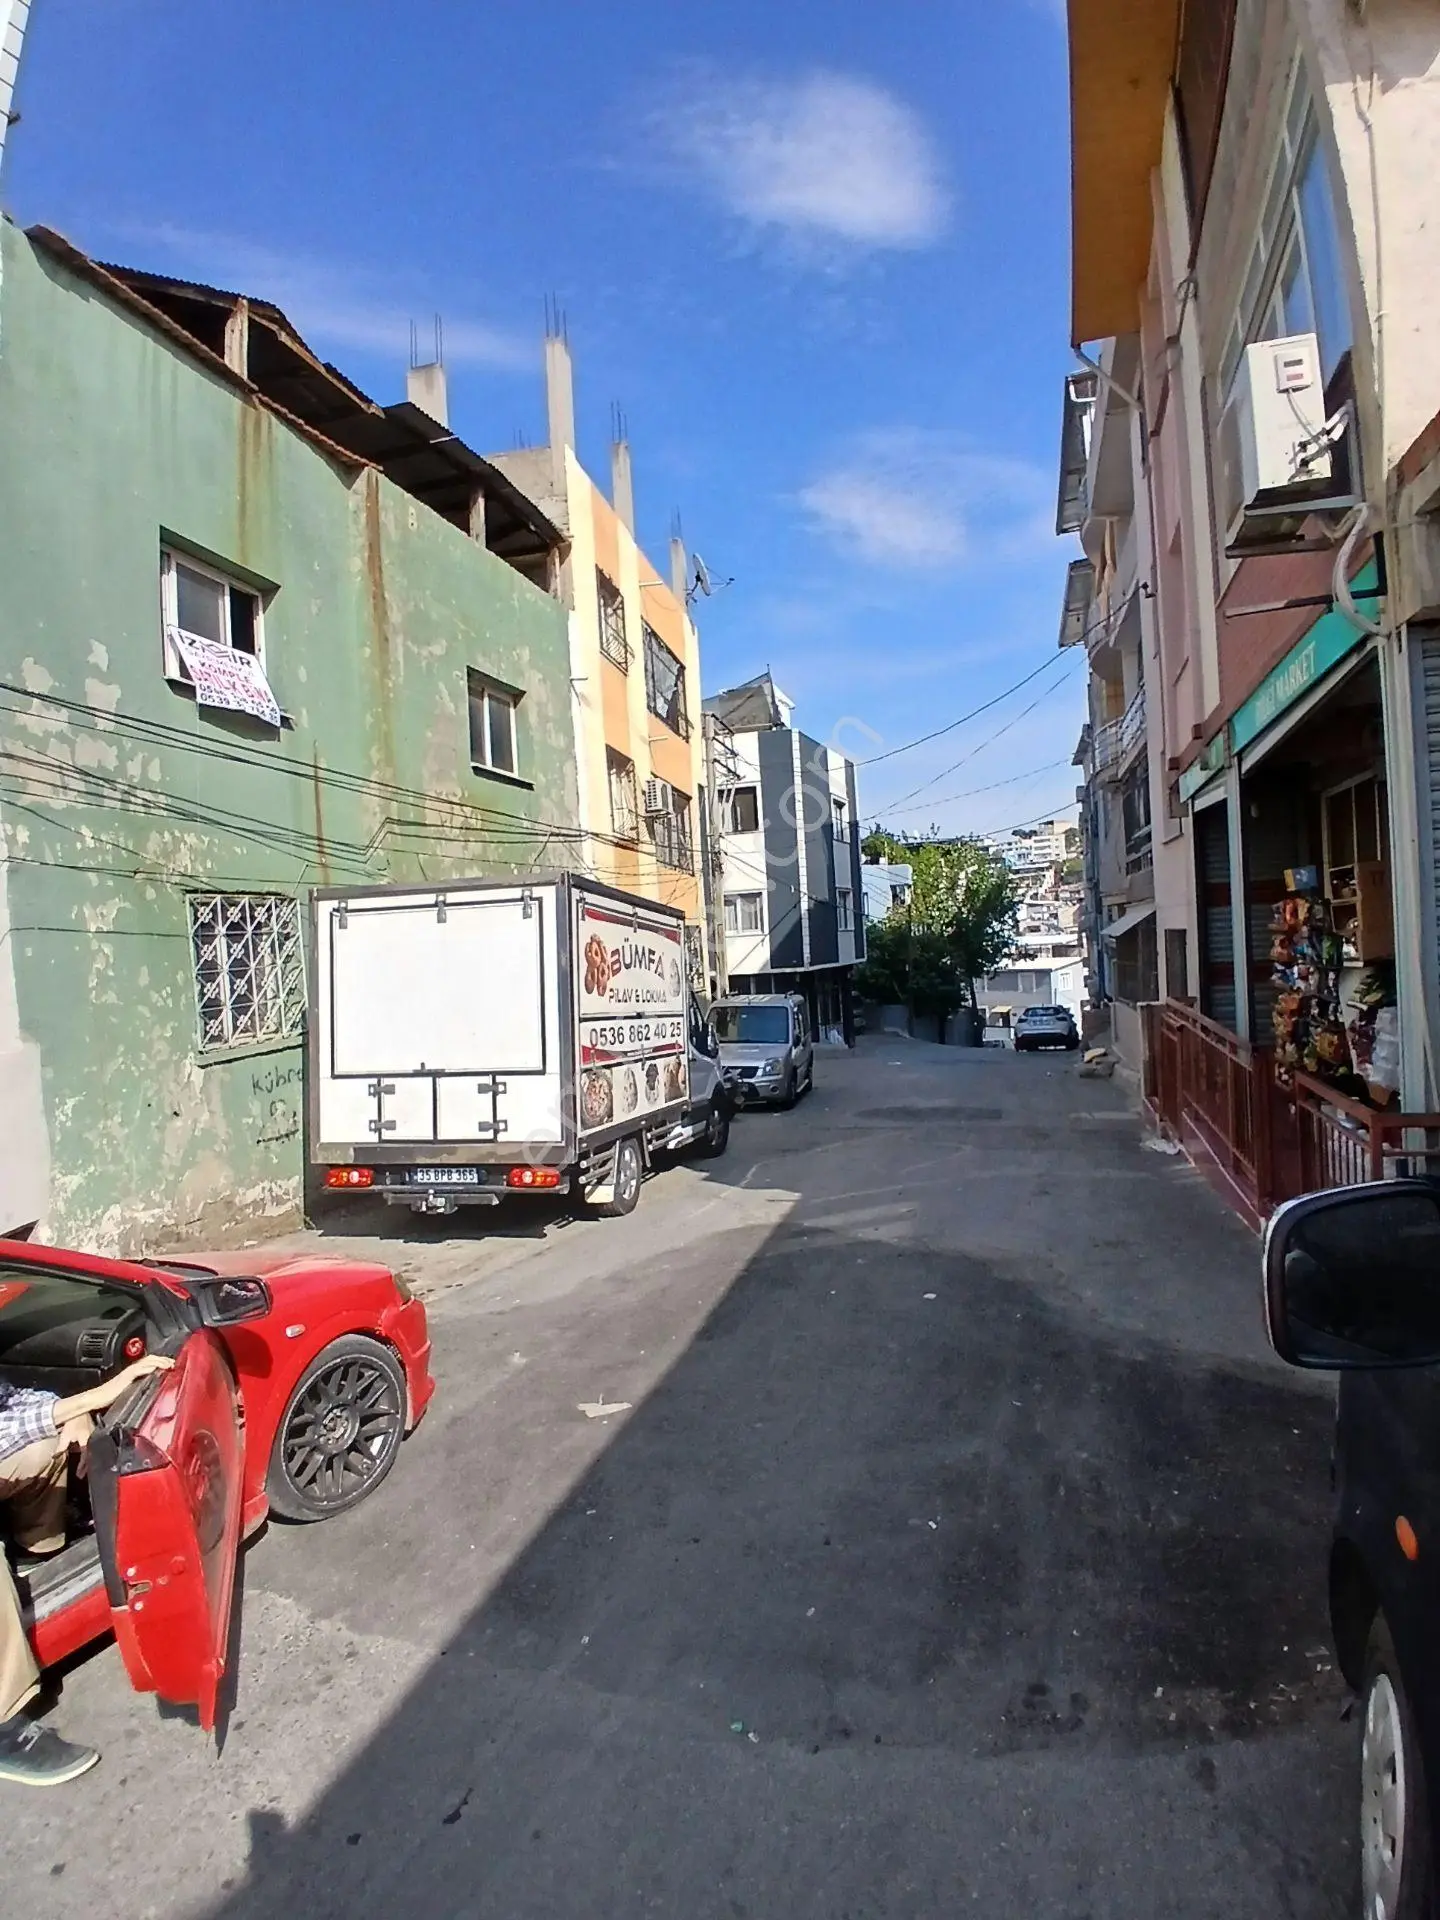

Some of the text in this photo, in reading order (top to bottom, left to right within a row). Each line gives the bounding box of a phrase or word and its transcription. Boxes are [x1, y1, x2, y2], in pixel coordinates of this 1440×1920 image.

[610, 937, 665, 981] BÜMFA
[590, 1022, 682, 1048] 0536 862 40 25
[419, 1169, 431, 1181] 35
